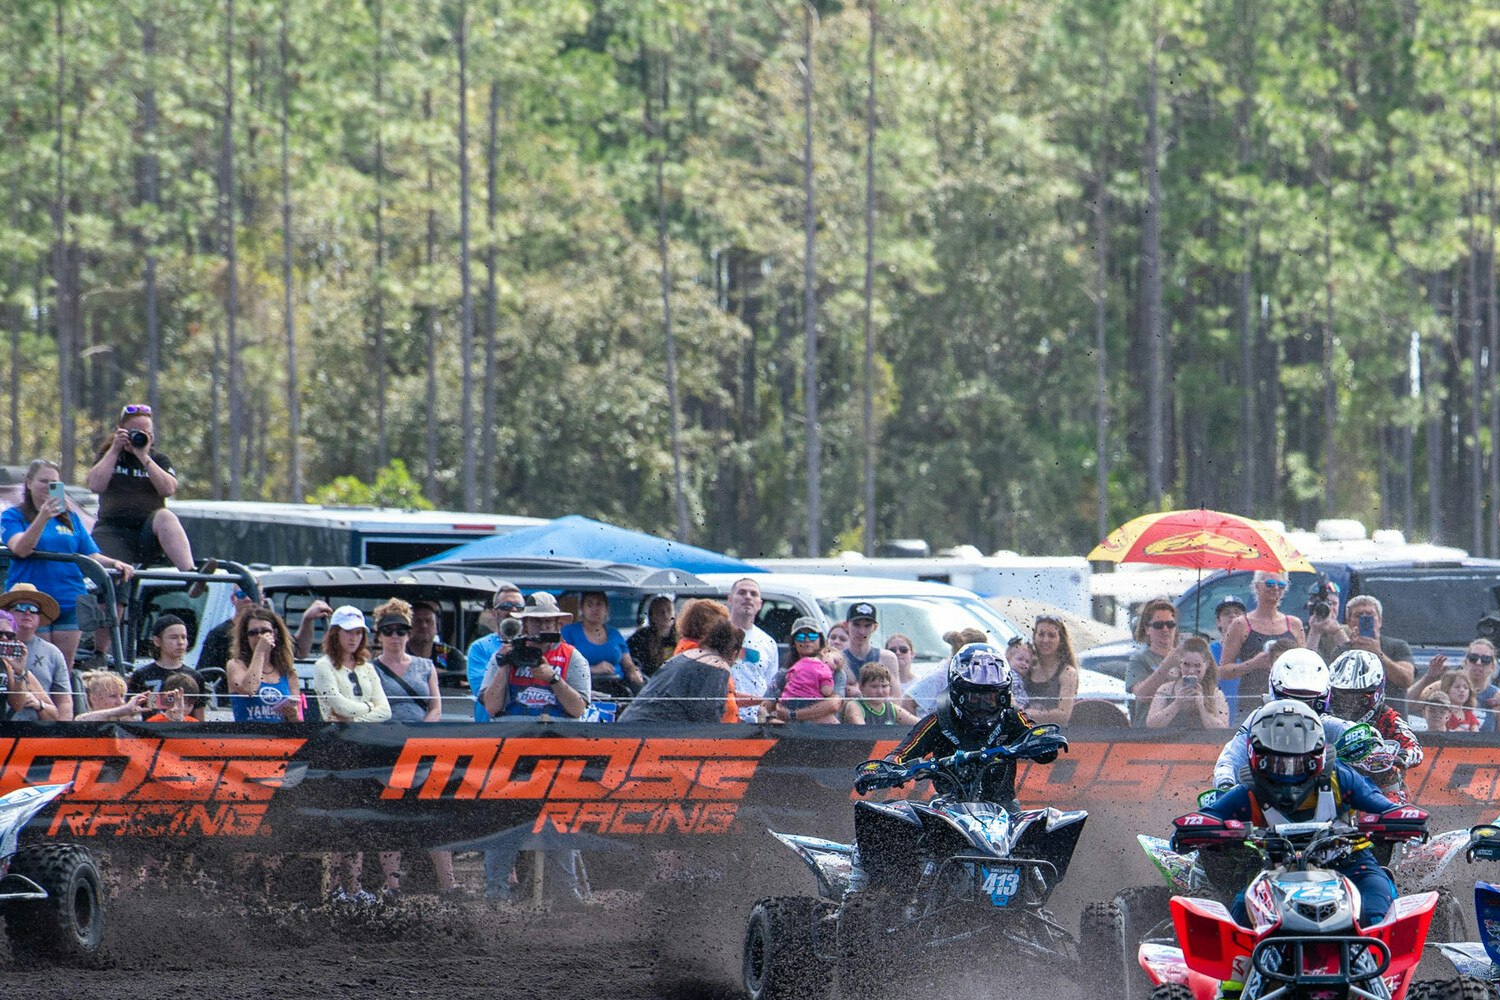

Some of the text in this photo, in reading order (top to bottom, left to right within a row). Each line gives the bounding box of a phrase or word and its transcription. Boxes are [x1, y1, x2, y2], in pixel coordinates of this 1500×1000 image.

[0, 737, 308, 801] OOSE
[379, 737, 780, 801] MOOSE
[531, 802, 739, 835] RACING
[1183, 815, 1204, 827] 723
[1400, 808, 1421, 820] 723
[980, 872, 1020, 897] 413
